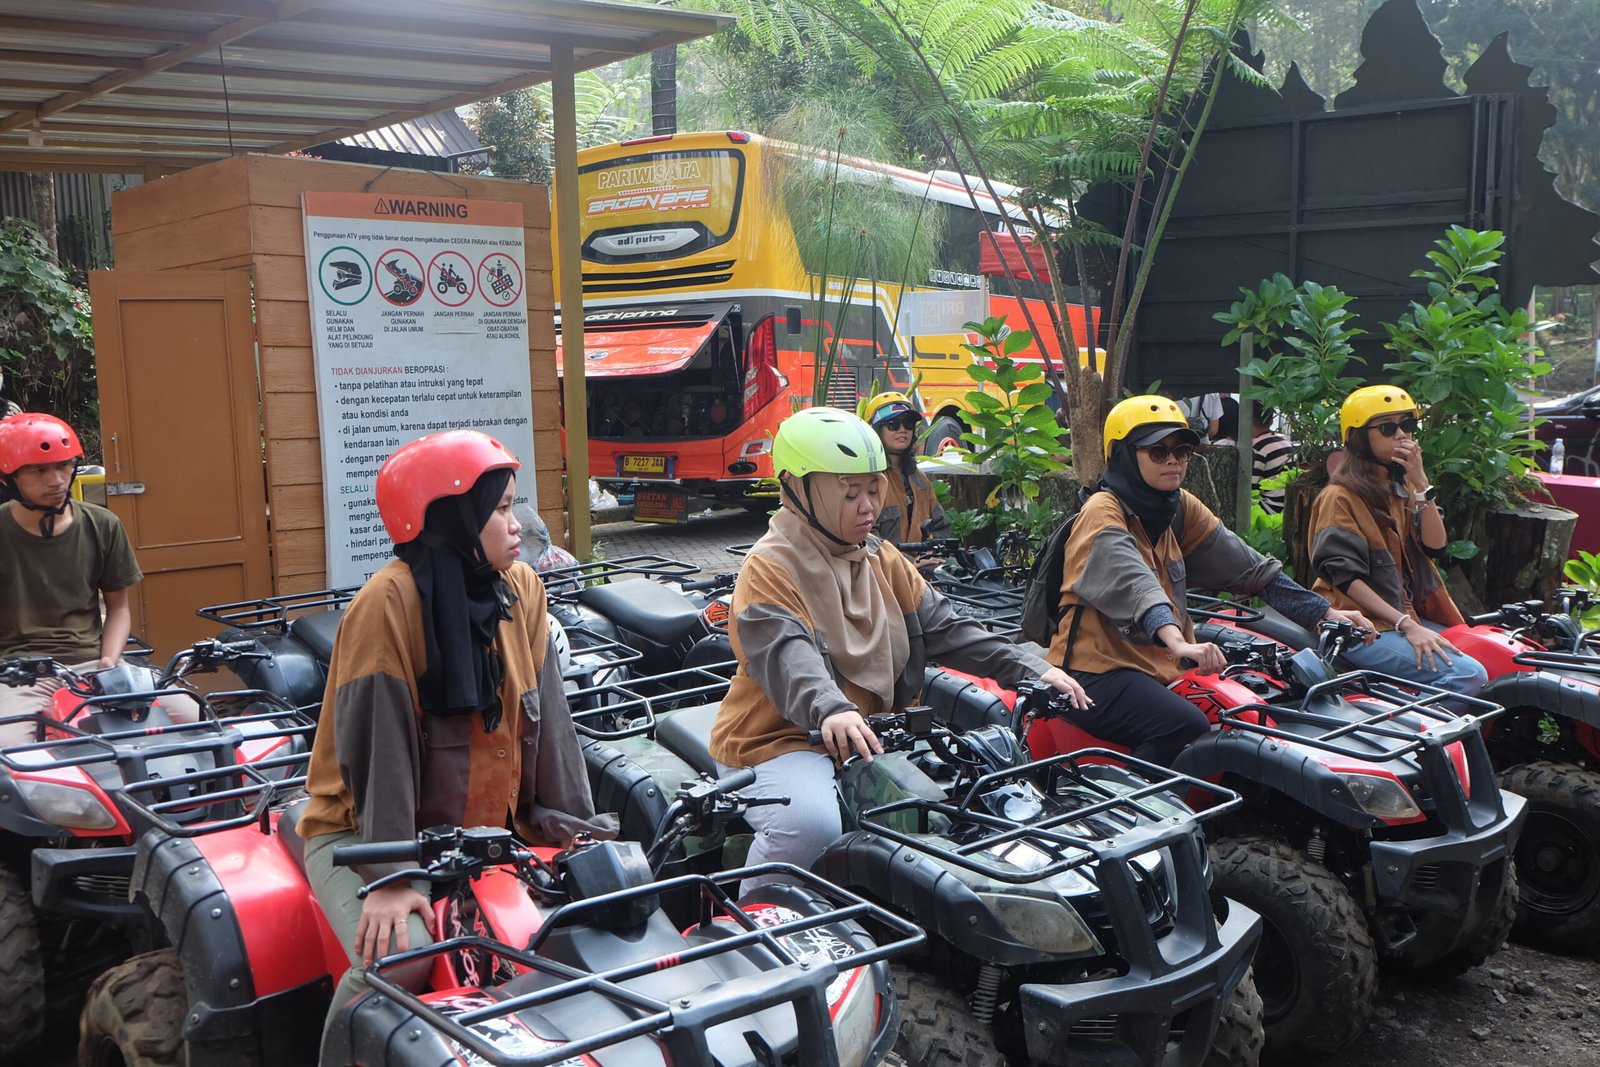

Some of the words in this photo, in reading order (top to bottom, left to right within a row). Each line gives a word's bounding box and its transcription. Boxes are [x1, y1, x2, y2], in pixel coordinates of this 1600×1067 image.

[598, 161, 701, 189] PARIWISATA
[389, 199, 468, 218] WARNING
[313, 231, 346, 239] Penggunaan
[617, 235, 634, 246] adi
[331, 367, 354, 376] TIDAK
[355, 366, 402, 376] DIANJURKAN
[404, 365, 446, 374] BEROPRASI
[339, 381, 361, 391] tanpa
[363, 380, 399, 391] pelatihan
[400, 380, 416, 388] atau
[418, 378, 446, 388] intruksi
[447, 379, 465, 389] yang
[465, 378, 484, 388] tepat
[340, 396, 370, 406] dengan
[371, 394, 410, 405] kecepatan
[411, 393, 435, 402] terlalu
[436, 392, 456, 402] cepat
[457, 391, 478, 400] untuk
[479, 389, 522, 400] keterampilan
[341, 411, 359, 420] atau
[360, 409, 389, 419] kondisi
[390, 408, 409, 417] anda
[342, 425, 350, 434] di
[351, 425, 371, 436] jalan
[372, 424, 399, 433] umum,
[400, 422, 425, 431] karena
[427, 421, 448, 431] dapat
[448, 419, 471, 430] terjadi
[472, 418, 502, 427] tabrakan
[503, 417, 528, 426] dengan
[343, 439, 384, 449] kendaraan
[385, 437, 400, 447] lain
[345, 454, 374, 465] dengan
[624, 457, 629, 466] B
[633, 457, 650, 467] 7217
[340, 484, 369, 494] SELALU
[348, 497, 376, 510] gunaka
[350, 526, 371, 535] kasar
[350, 537, 377, 548] hindari
